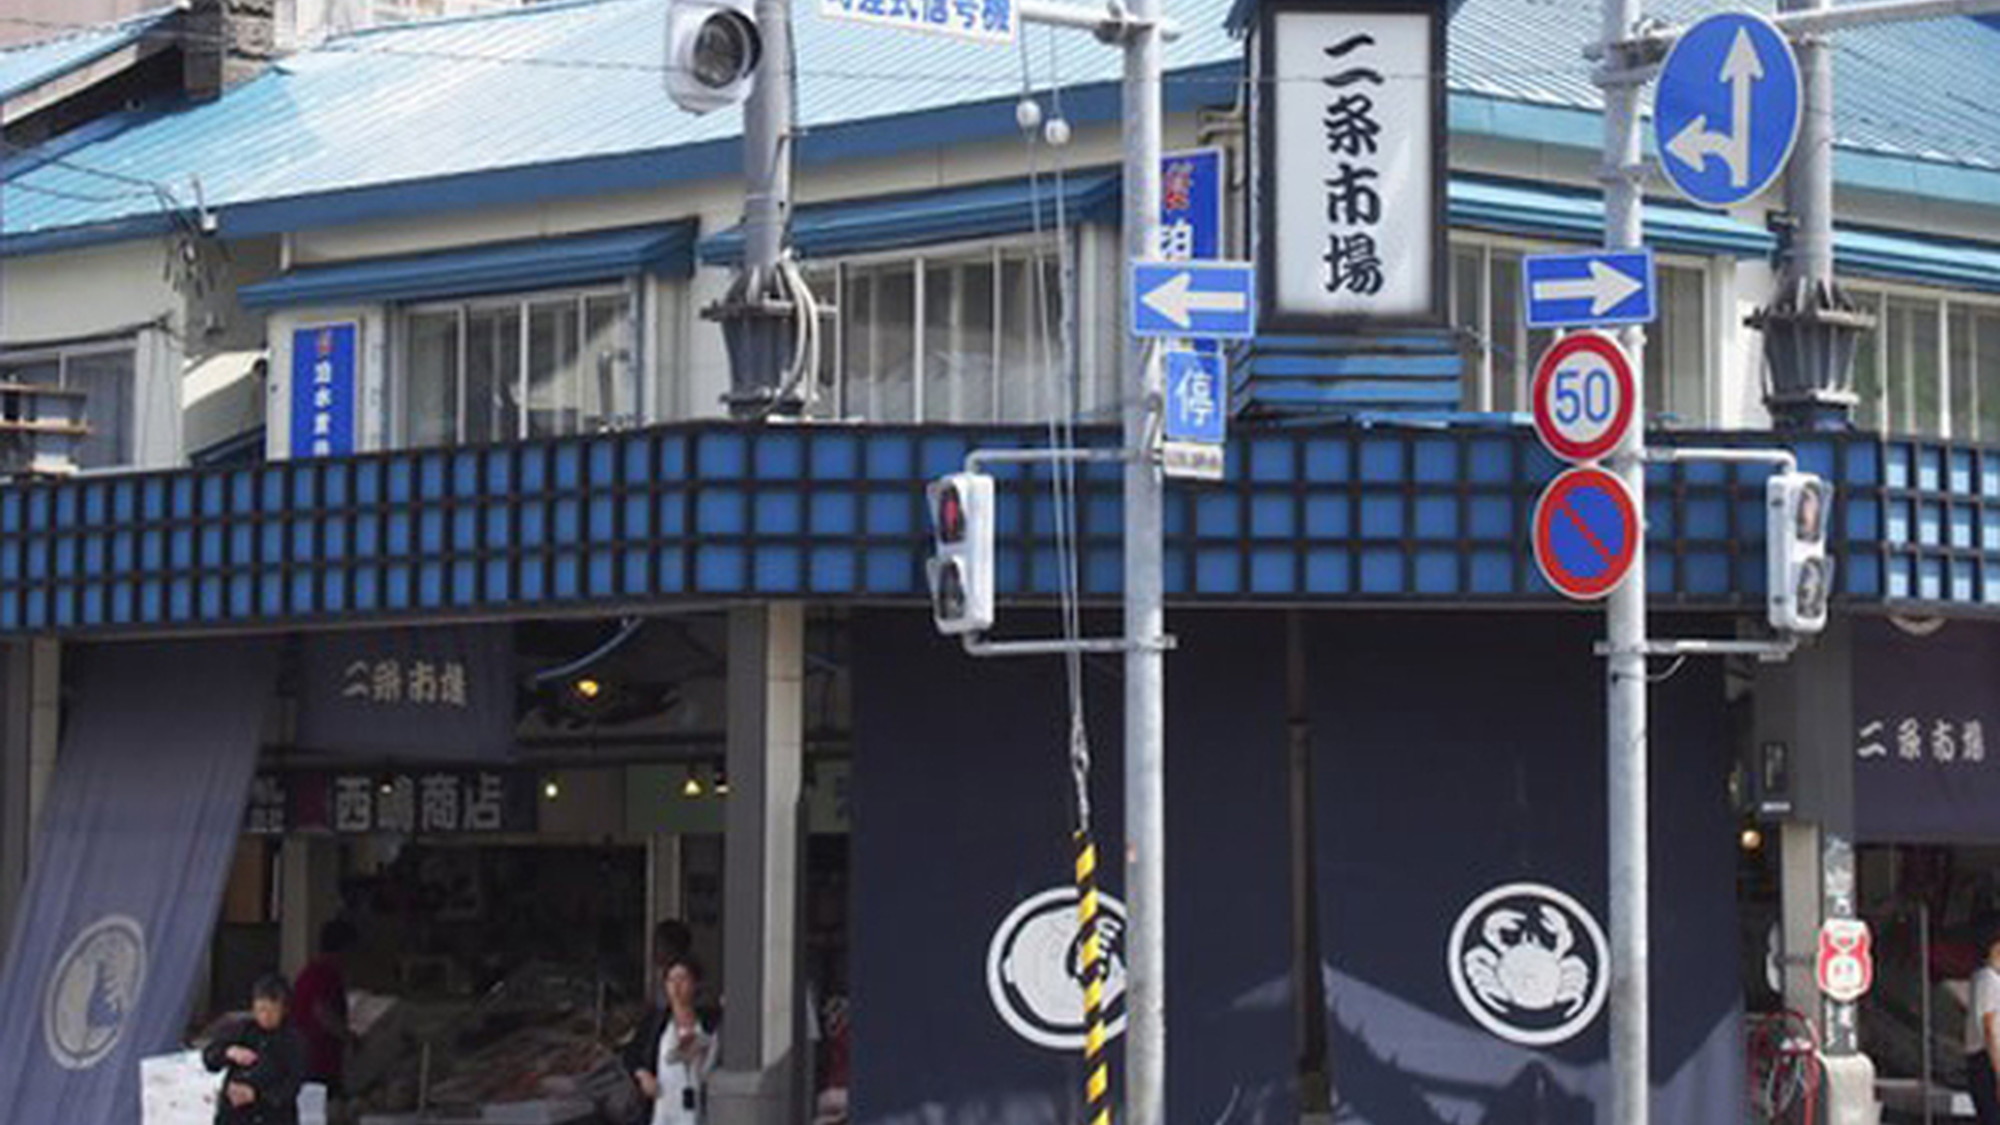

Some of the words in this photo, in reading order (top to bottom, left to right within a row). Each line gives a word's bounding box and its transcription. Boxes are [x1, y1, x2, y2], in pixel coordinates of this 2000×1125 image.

[1322, 33, 1384, 296] 二条市場
[1174, 367, 1214, 428] 停
[1556, 368, 1611, 424] 50
[1857, 717, 1984, 762] 二条市場
